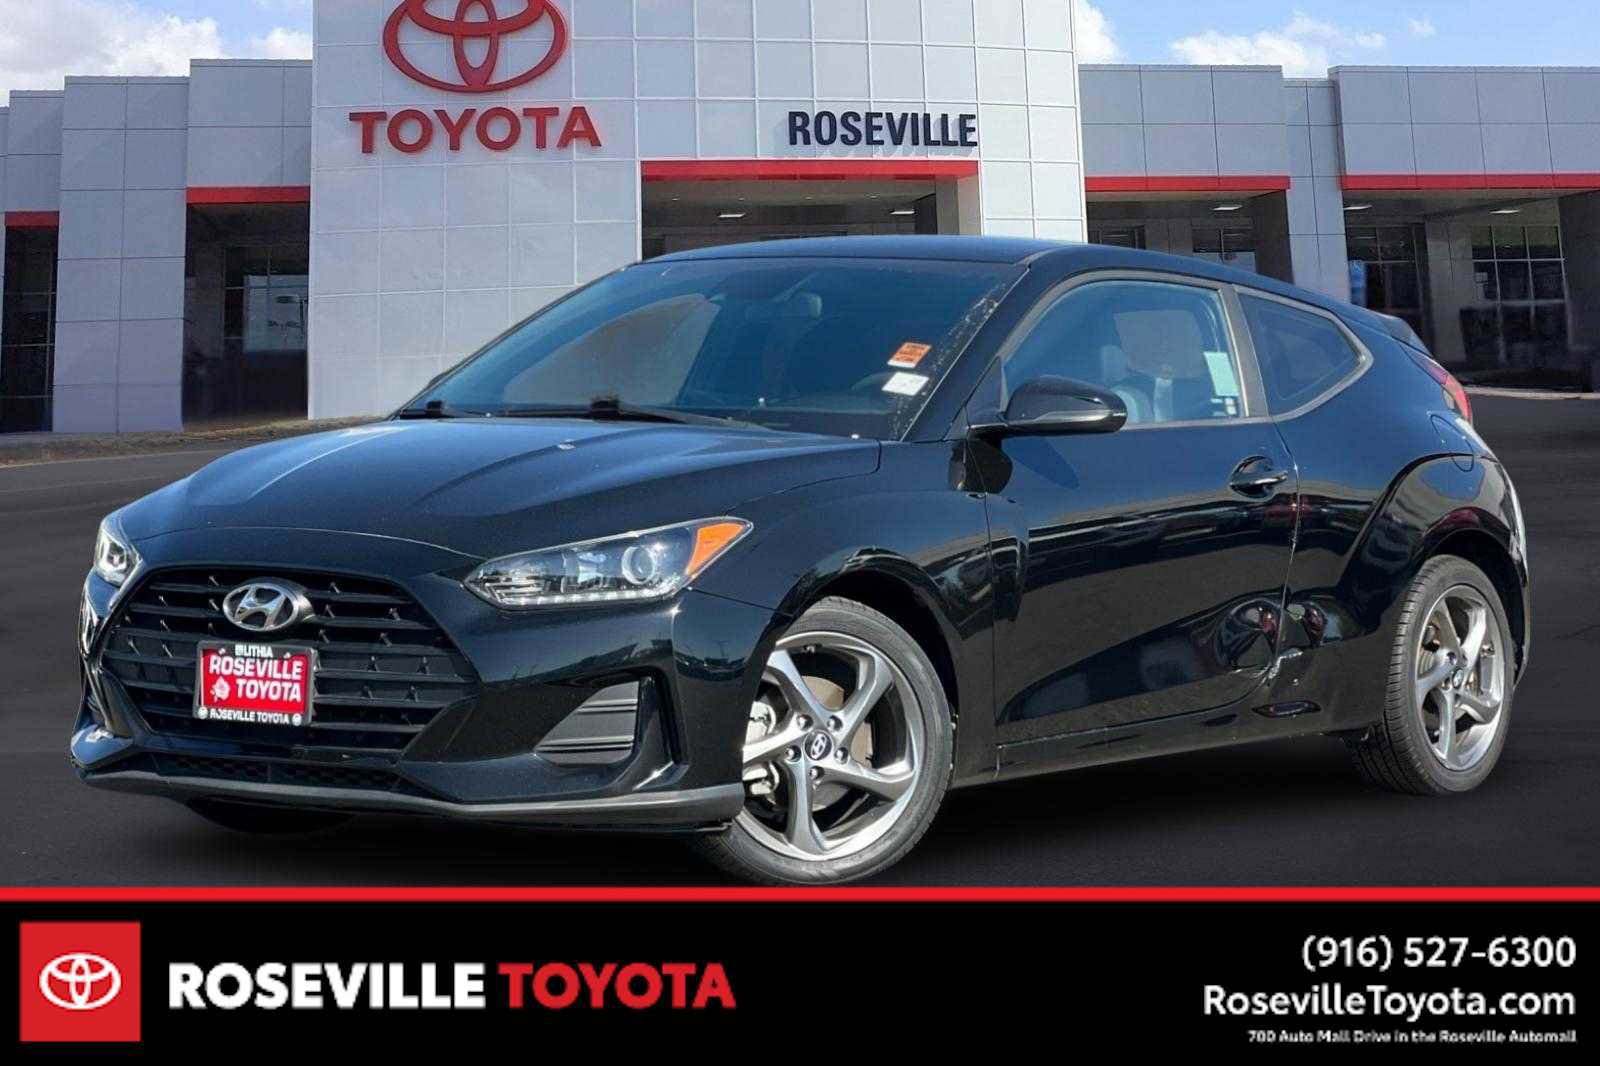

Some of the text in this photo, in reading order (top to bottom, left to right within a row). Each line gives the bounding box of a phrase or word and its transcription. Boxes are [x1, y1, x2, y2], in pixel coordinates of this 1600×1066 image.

[350, 106, 602, 153] TOYOTA
[788, 111, 978, 147] ROSEVILLE
[243, 644, 274, 657] LITHIA
[208, 655, 303, 680] ROSEVILLE
[235, 678, 302, 703] TOYOTA
[210, 708, 290, 724] ROSEVILLE TOYOTA
